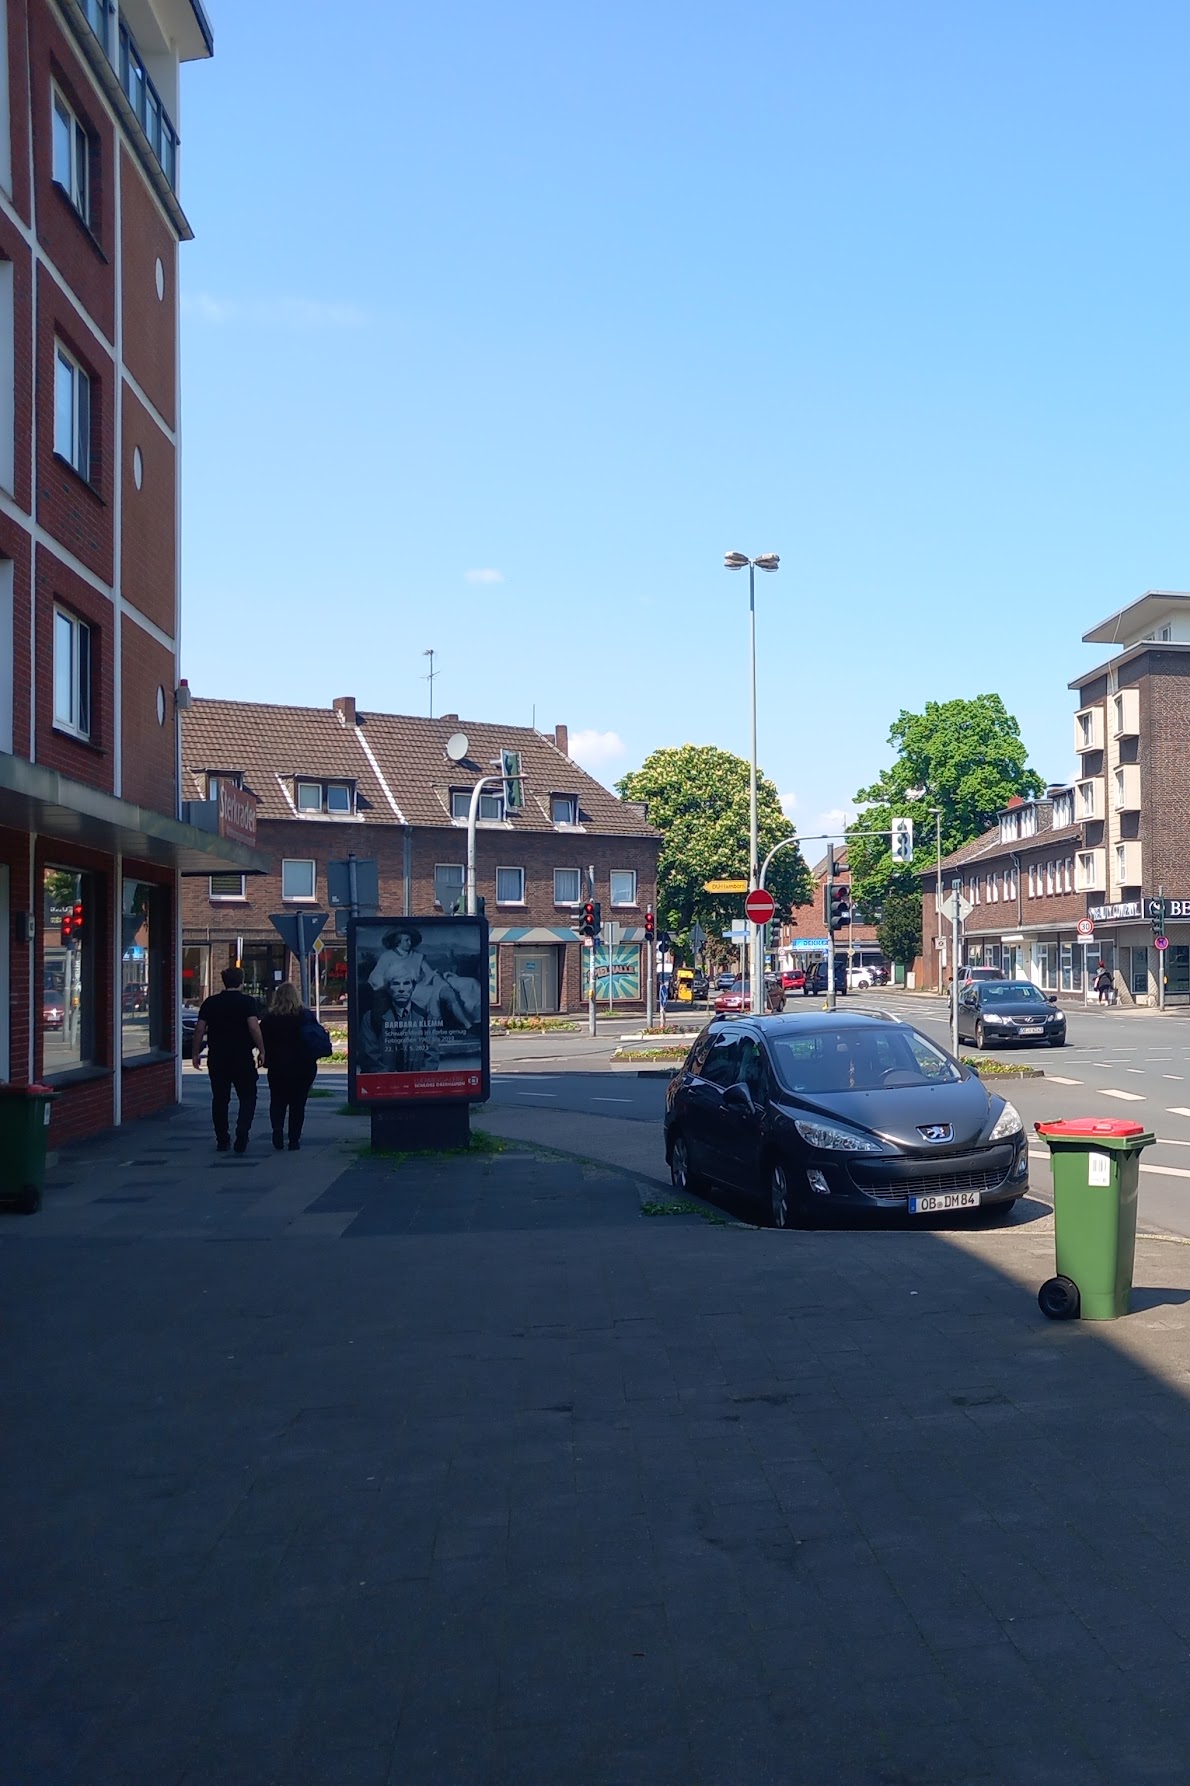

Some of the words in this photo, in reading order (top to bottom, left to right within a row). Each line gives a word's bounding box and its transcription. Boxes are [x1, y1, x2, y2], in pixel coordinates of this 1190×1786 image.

[220, 786, 256, 832] Sterkrader
[1081, 923, 1090, 931] 30
[921, 1197, 936, 1211] OB
[944, 1194, 959, 1208] DM
[961, 1192, 975, 1206] 84
